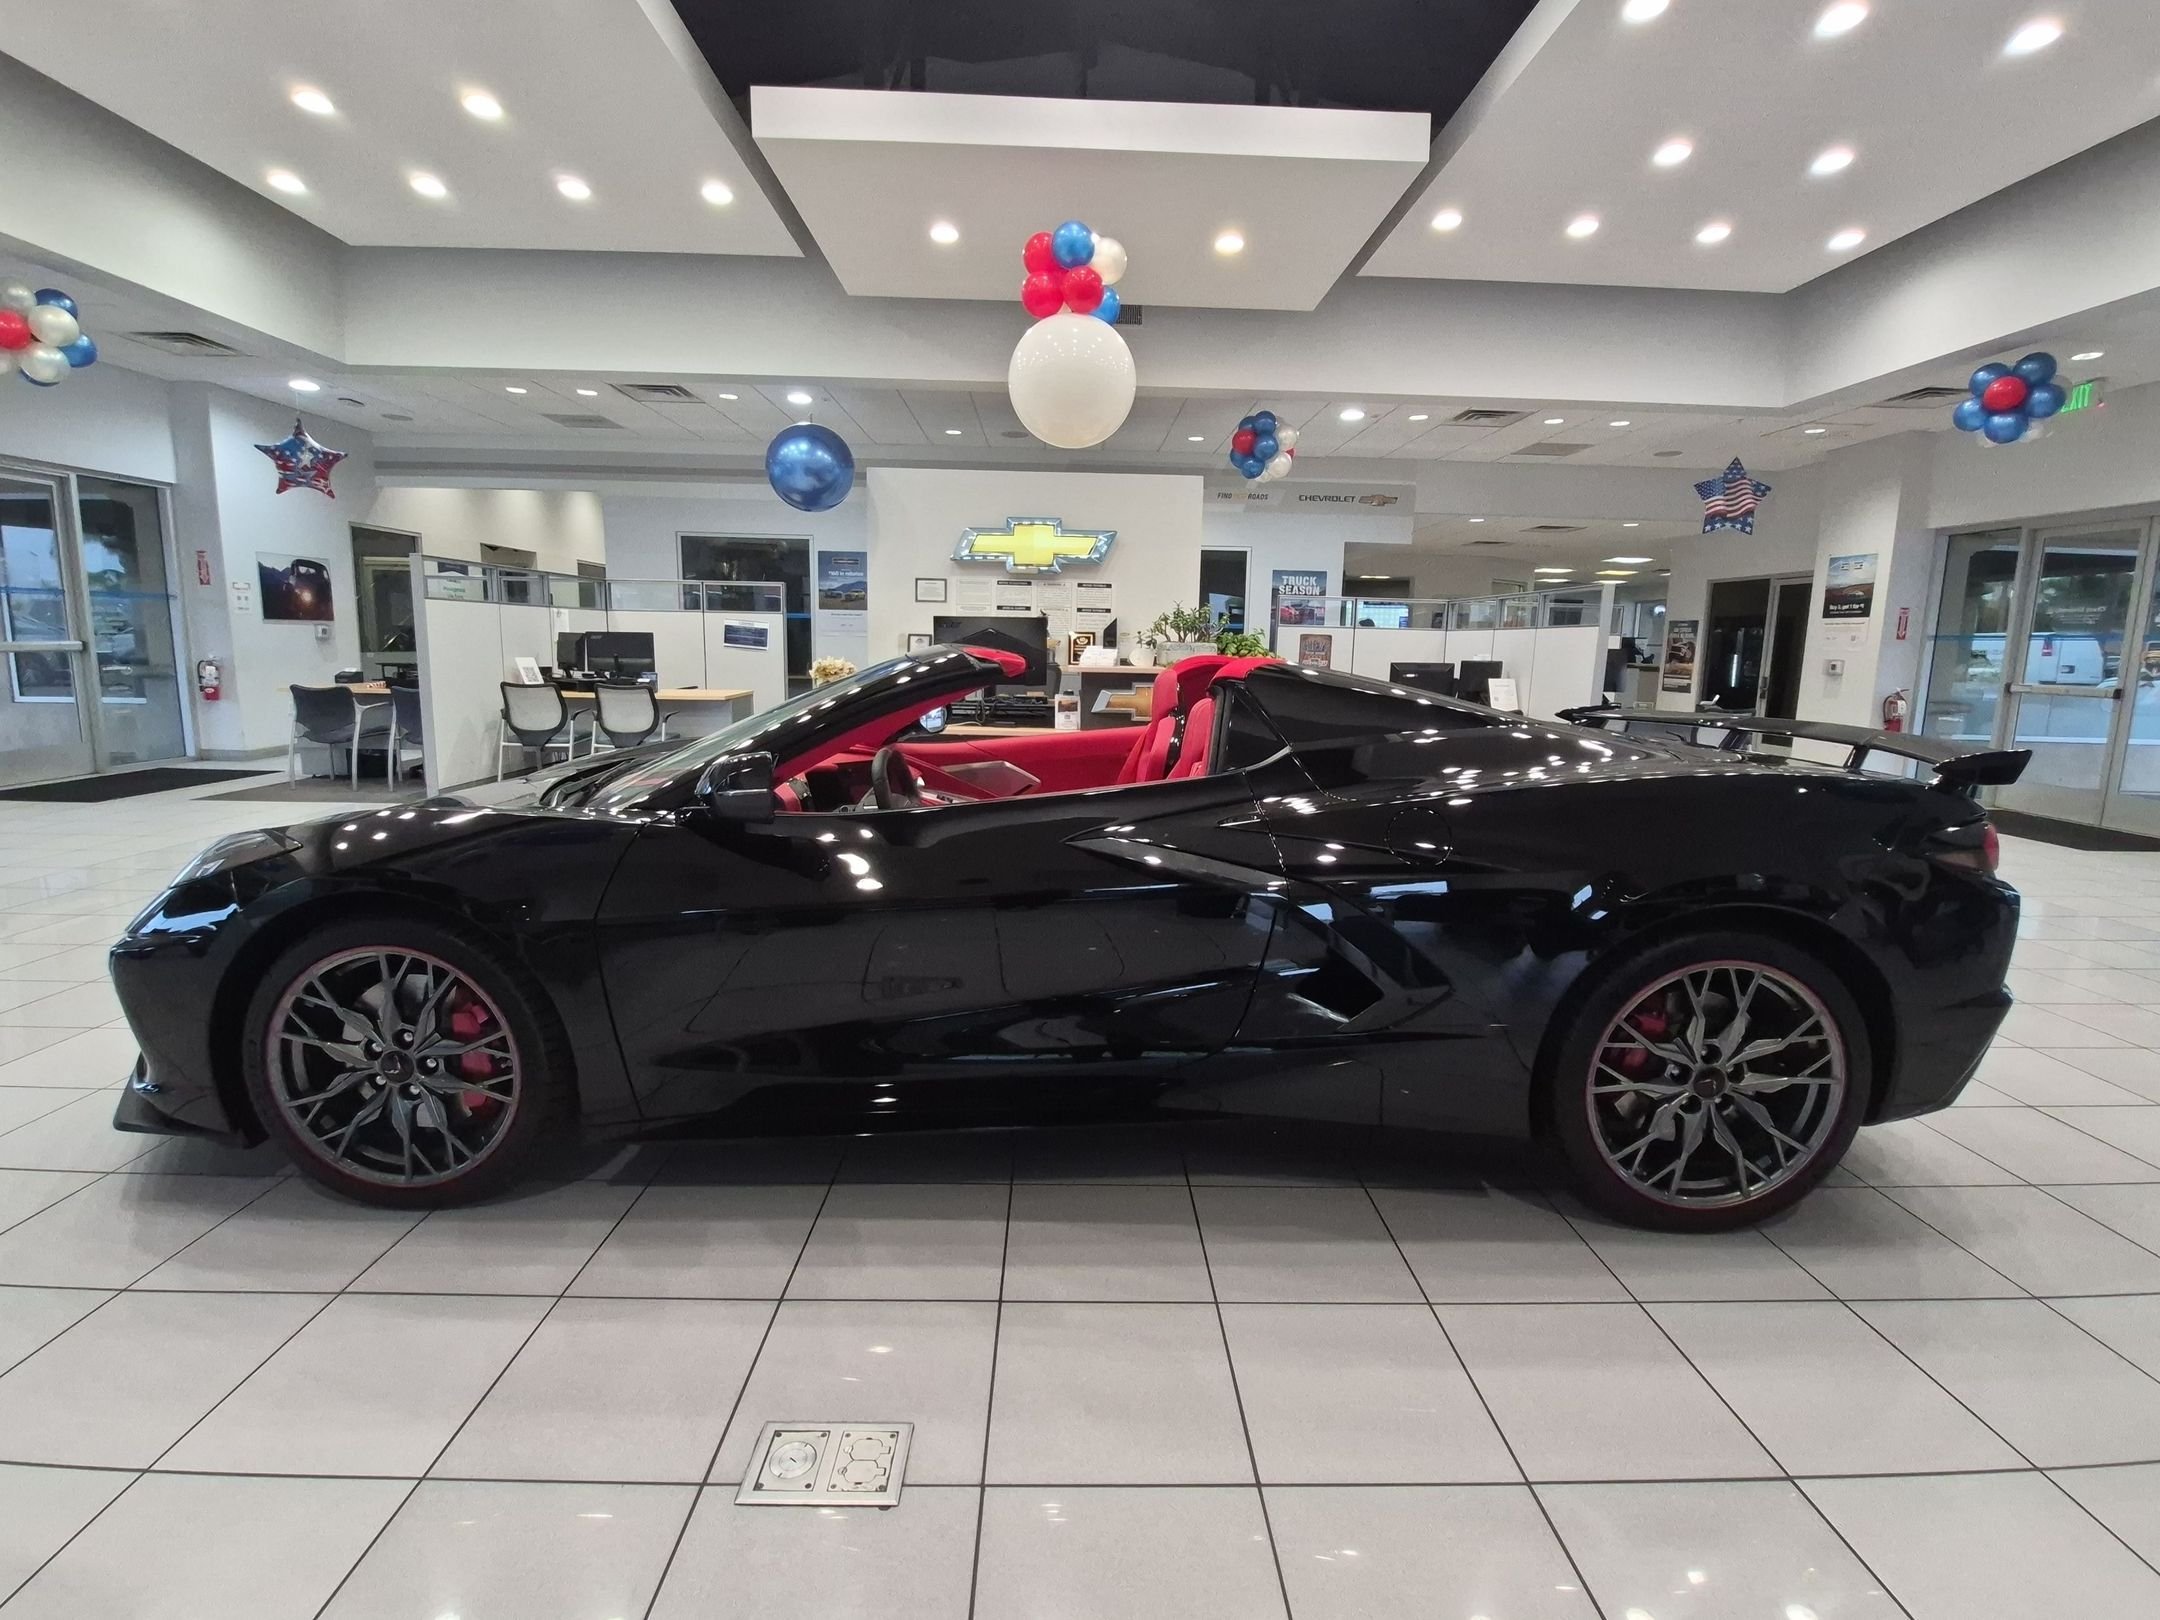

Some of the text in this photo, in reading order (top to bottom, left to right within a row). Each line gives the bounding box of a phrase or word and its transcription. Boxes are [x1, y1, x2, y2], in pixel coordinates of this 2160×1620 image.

[1298, 494, 1356, 503] CHEVROLET
[1281, 575, 1317, 586] TRUCK
[1278, 585, 1320, 595] SEASON
